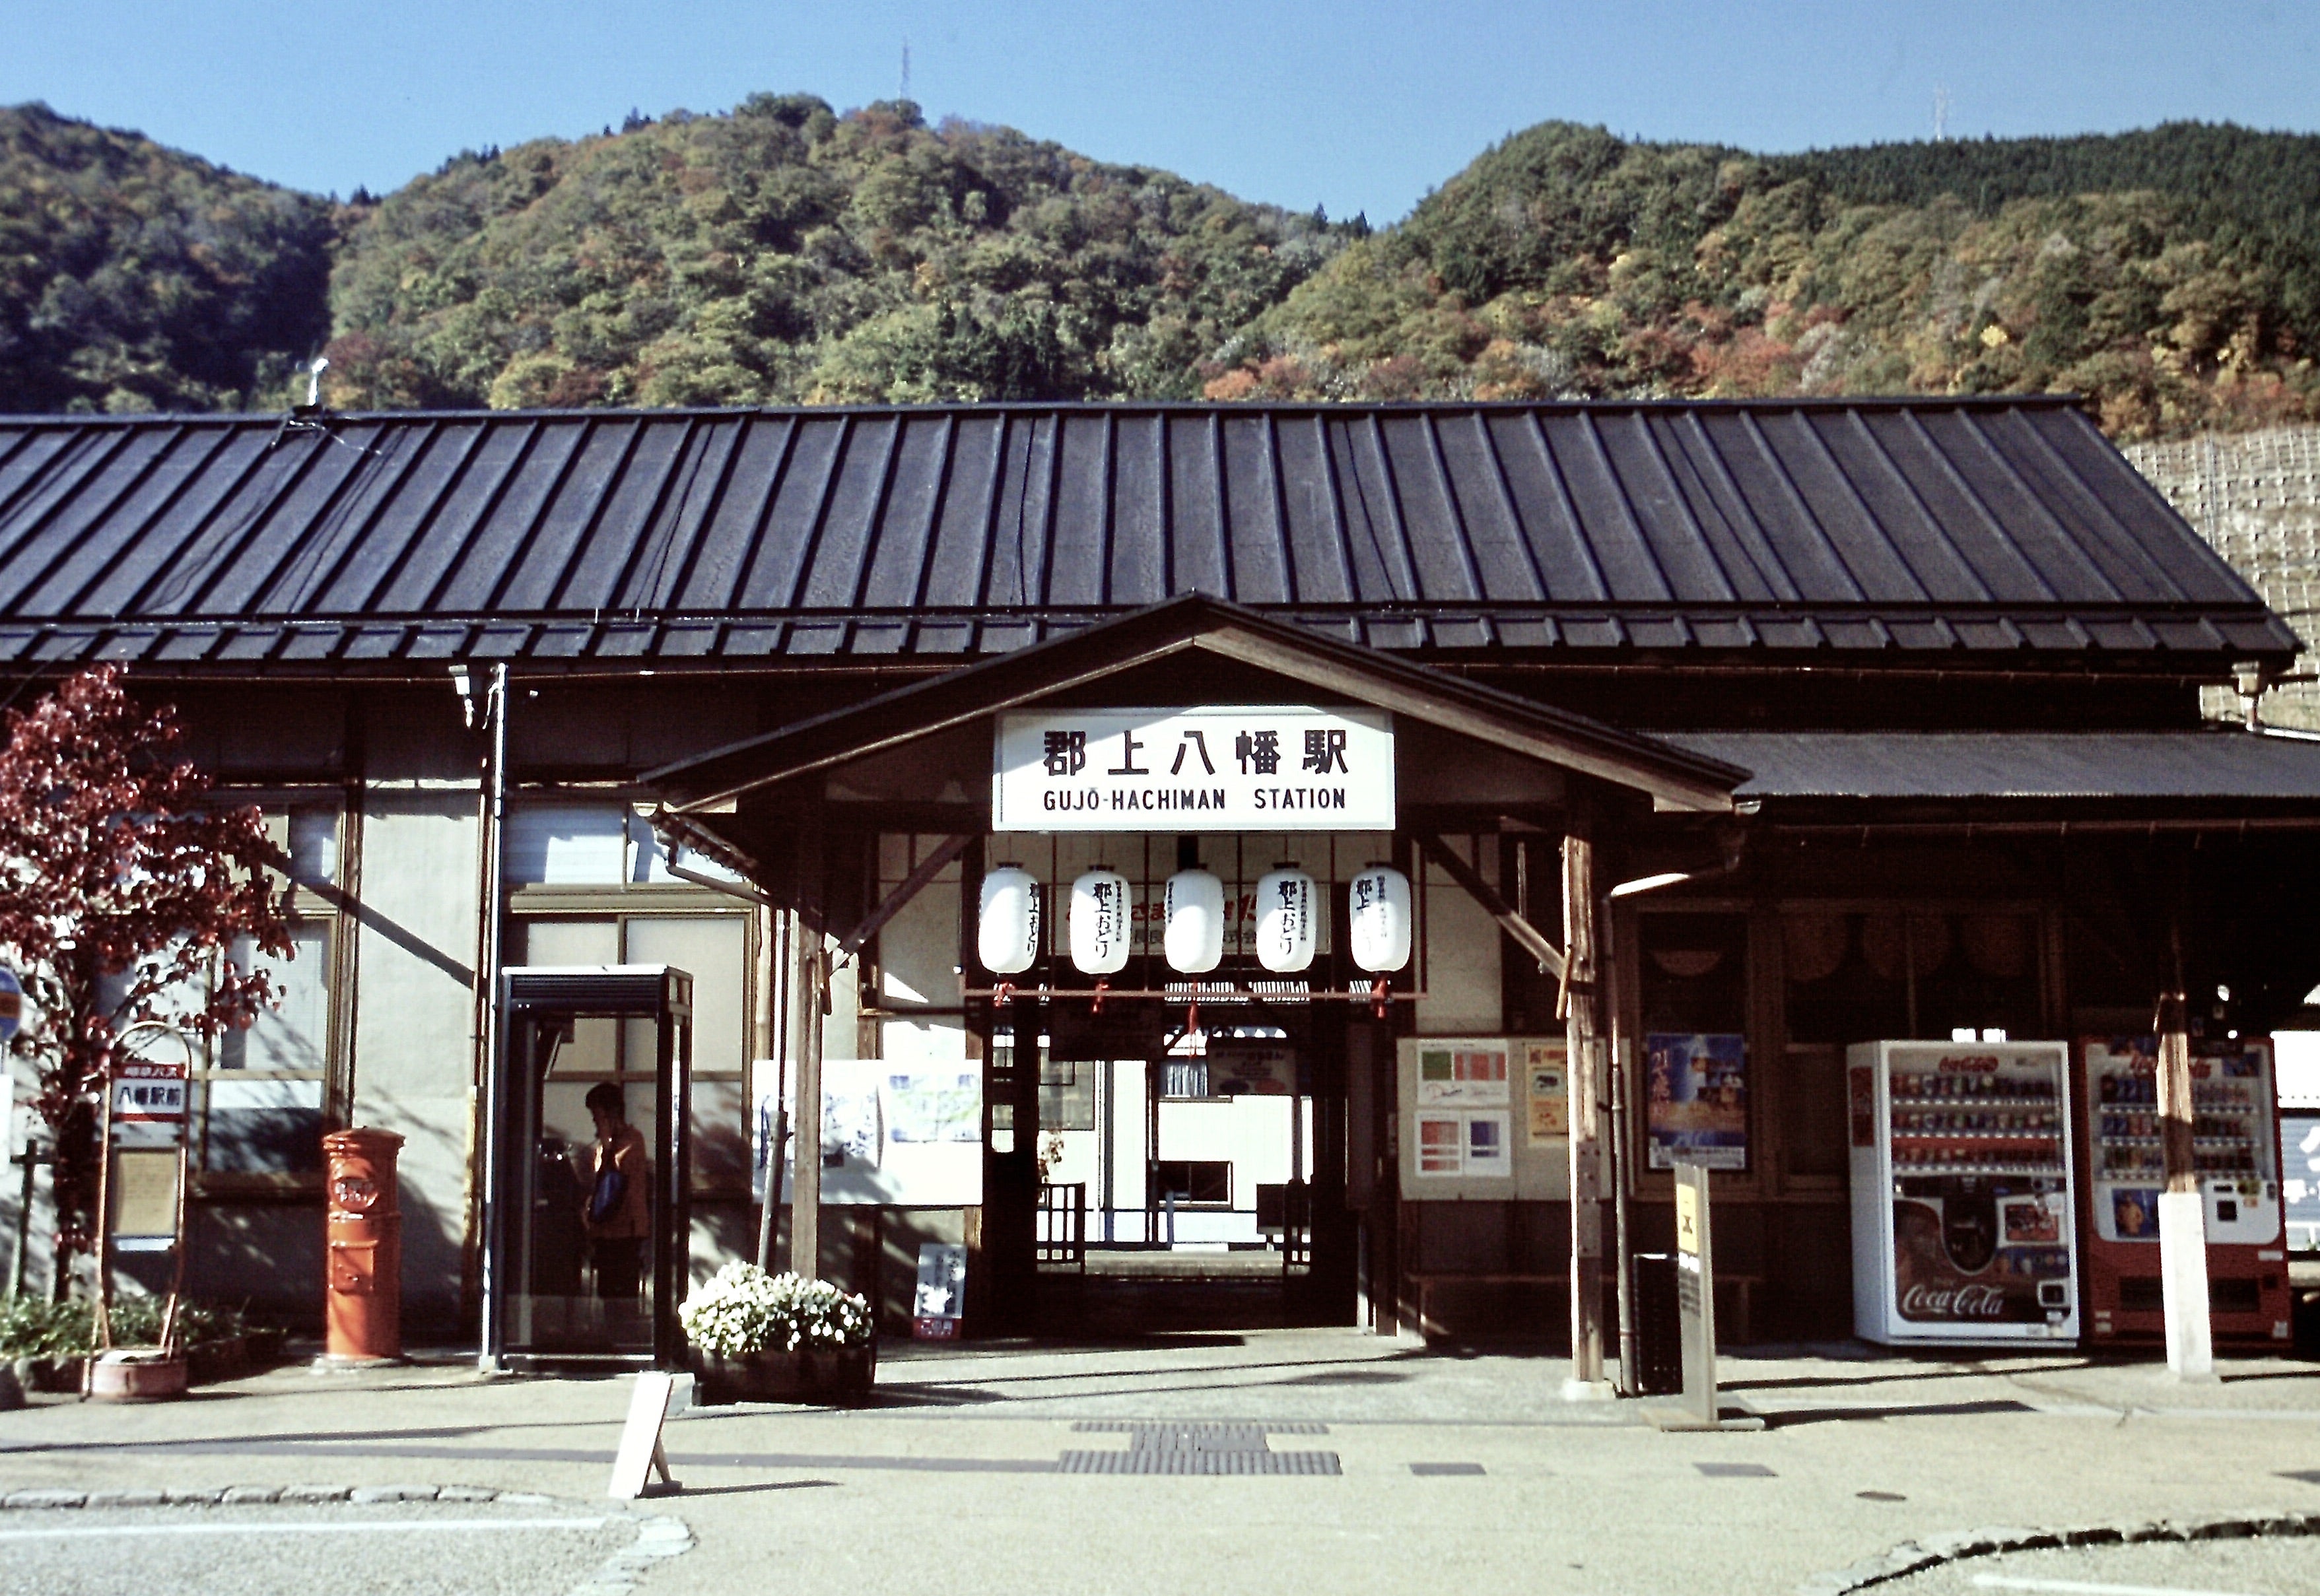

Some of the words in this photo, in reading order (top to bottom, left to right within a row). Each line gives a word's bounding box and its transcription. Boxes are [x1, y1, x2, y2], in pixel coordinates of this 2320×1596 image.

[1043, 729, 1349, 776] 郡上八幡駅
[1254, 788, 1346, 809] STATION
[1093, 882, 1112, 958] 郡上おどり
[1278, 880, 1297, 955] 郡上おどり
[125, 1066, 178, 1077] バス
